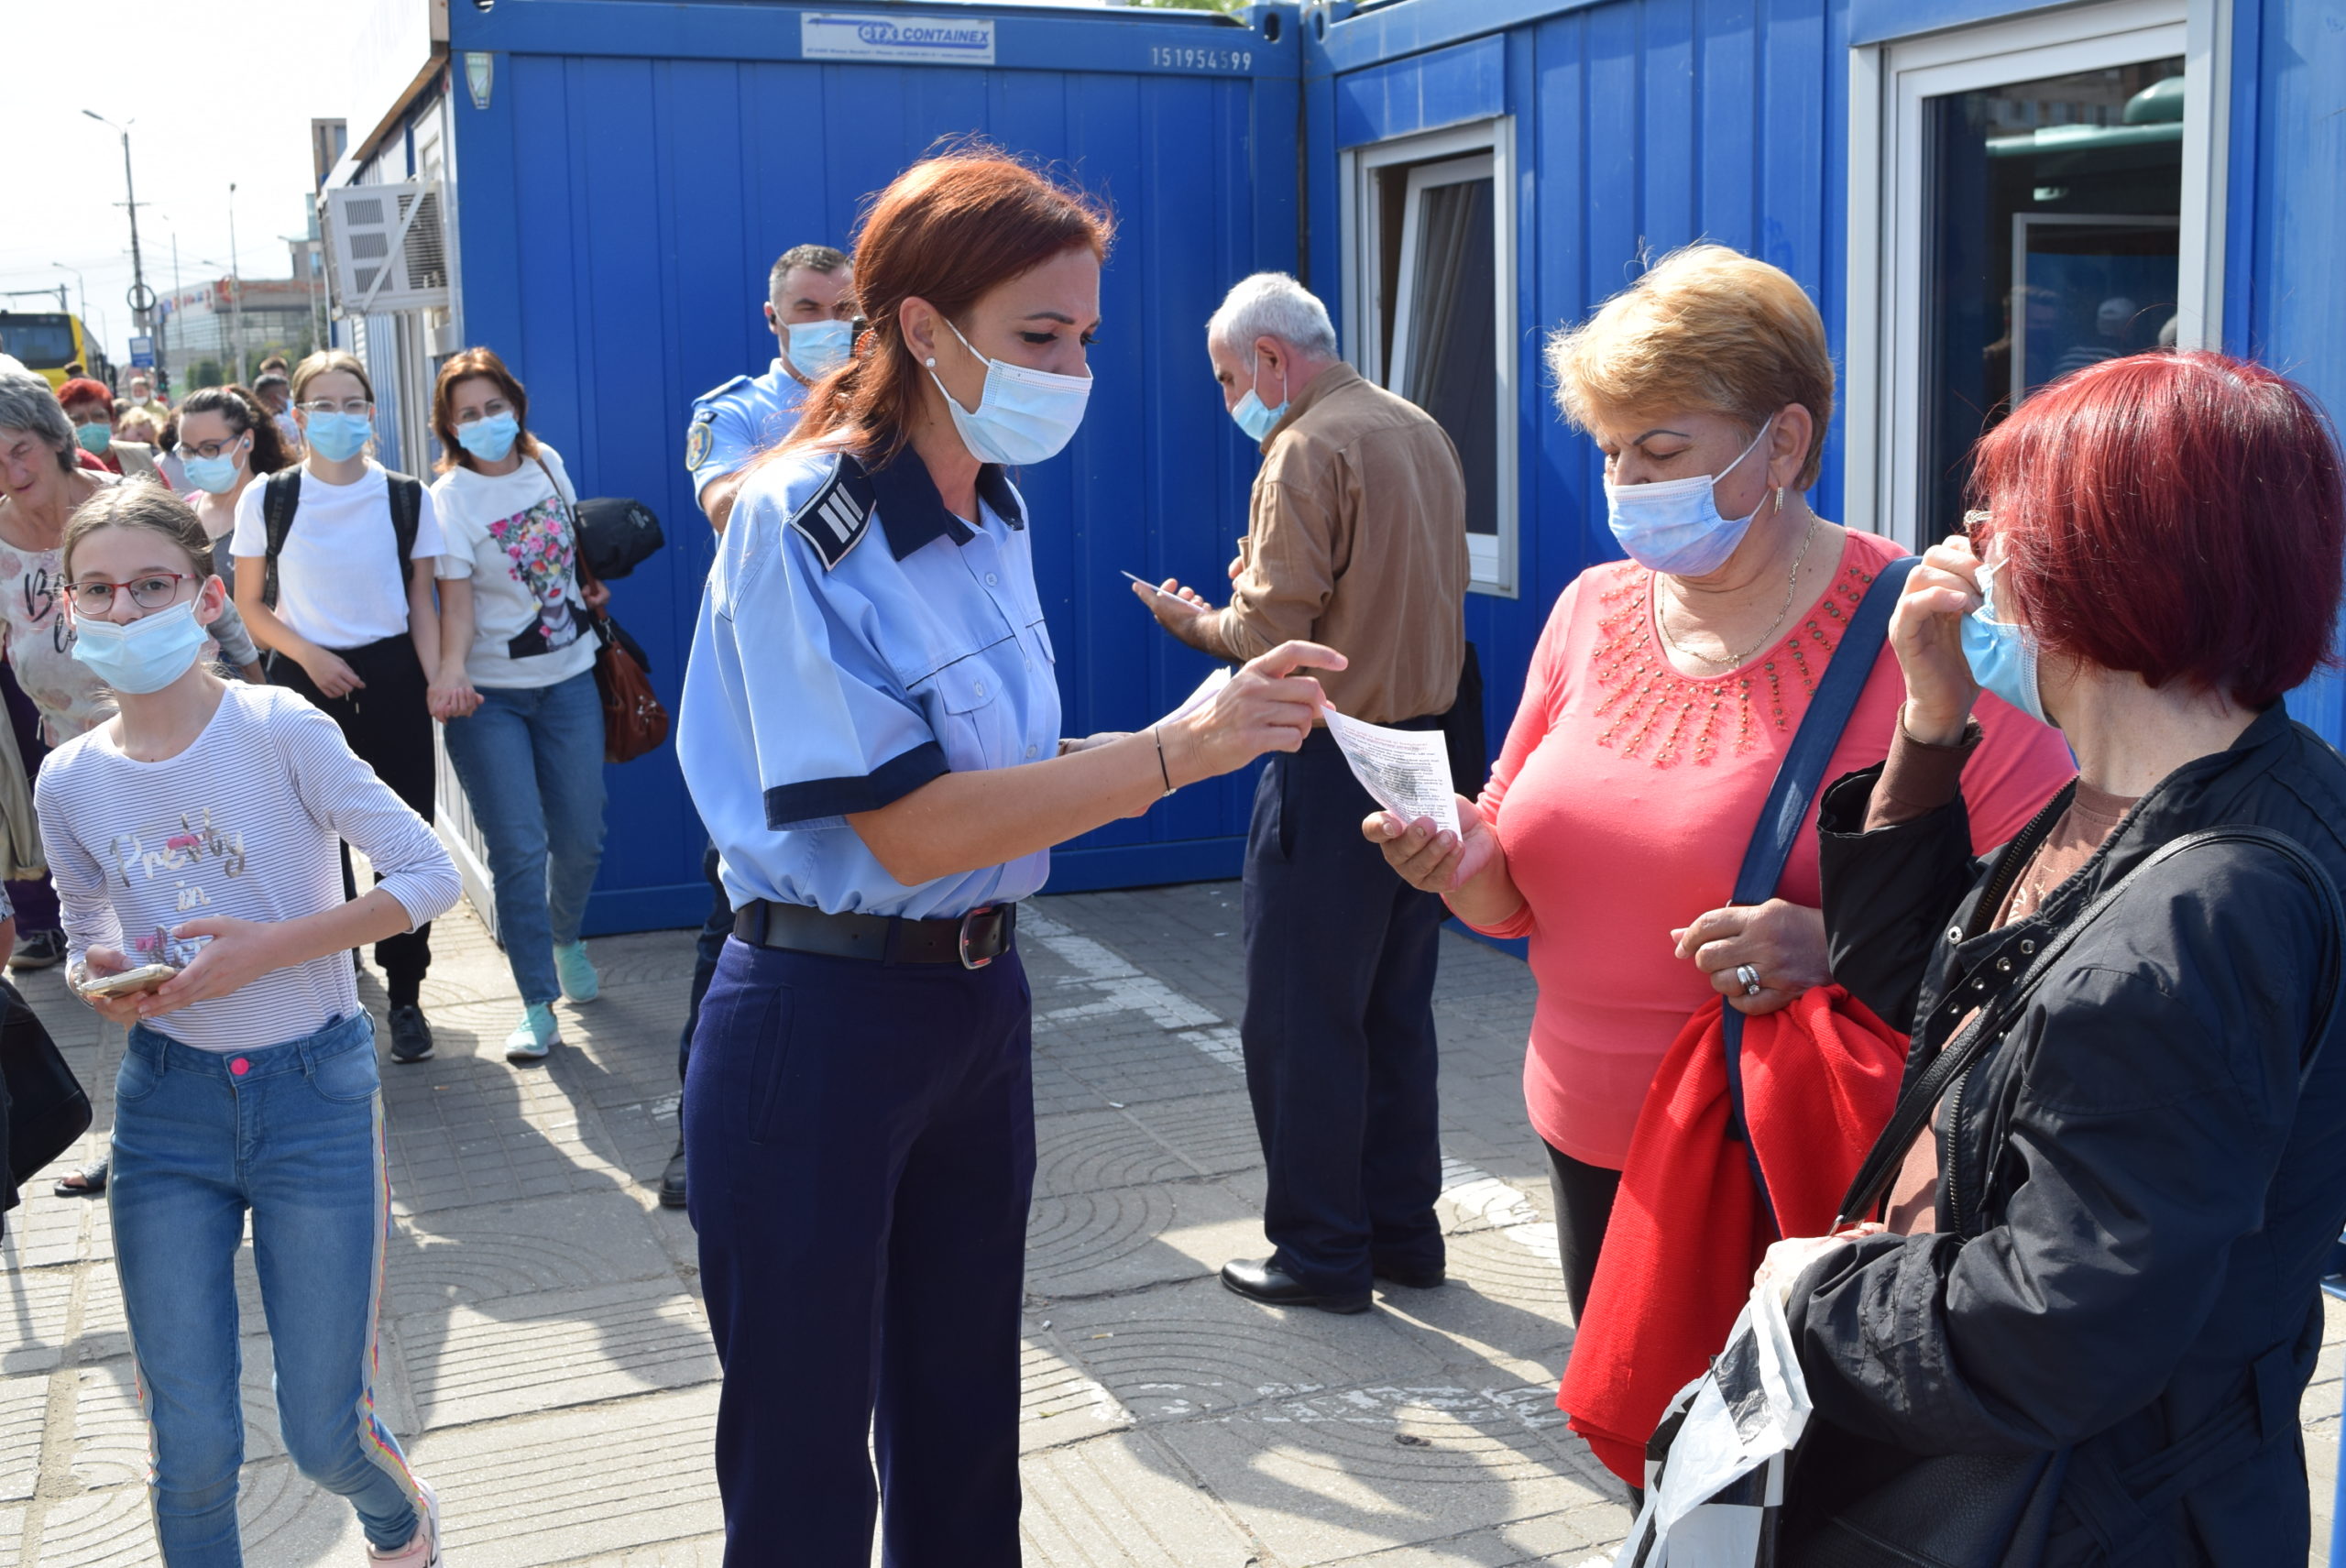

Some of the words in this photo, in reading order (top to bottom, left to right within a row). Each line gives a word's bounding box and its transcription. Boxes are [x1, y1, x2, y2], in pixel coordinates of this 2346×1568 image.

[903, 27, 990, 43] CONTAINEX
[1152, 47, 1252, 71] 151954599
[109, 806, 246, 888] Pretty
[175, 880, 212, 912] in
